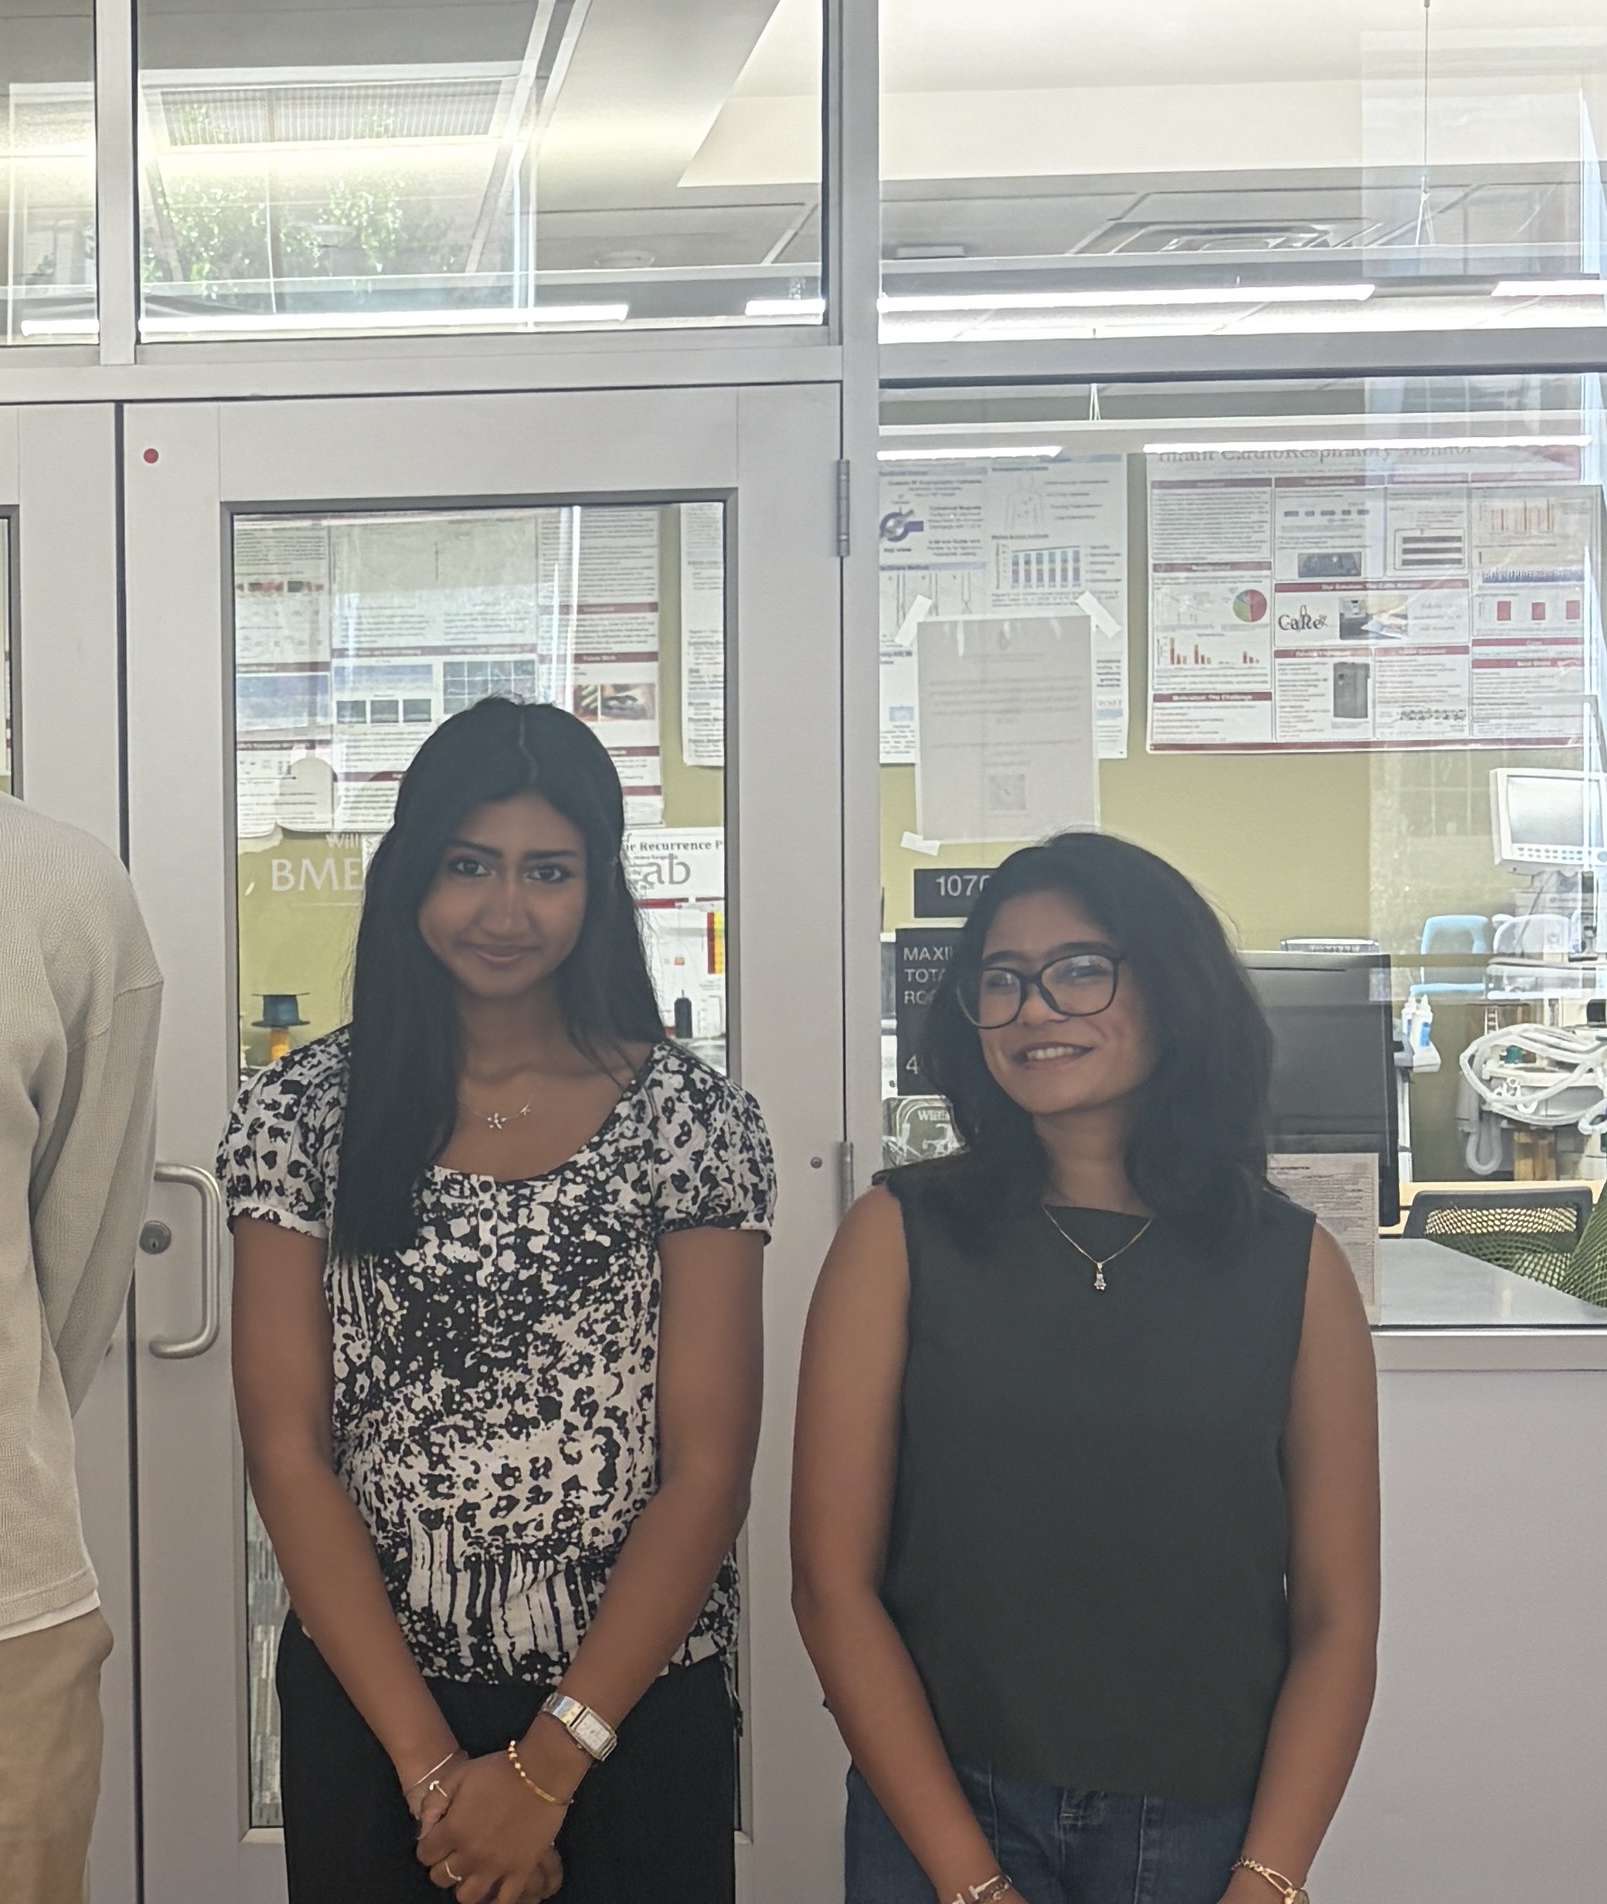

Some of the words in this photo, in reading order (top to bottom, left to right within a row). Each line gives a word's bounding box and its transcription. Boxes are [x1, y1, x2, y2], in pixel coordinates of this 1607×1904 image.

[640, 841, 712, 851] Recurrence
[271, 858, 363, 891] BME
[641, 853, 691, 885] ab
[903, 946, 953, 961] MAXI
